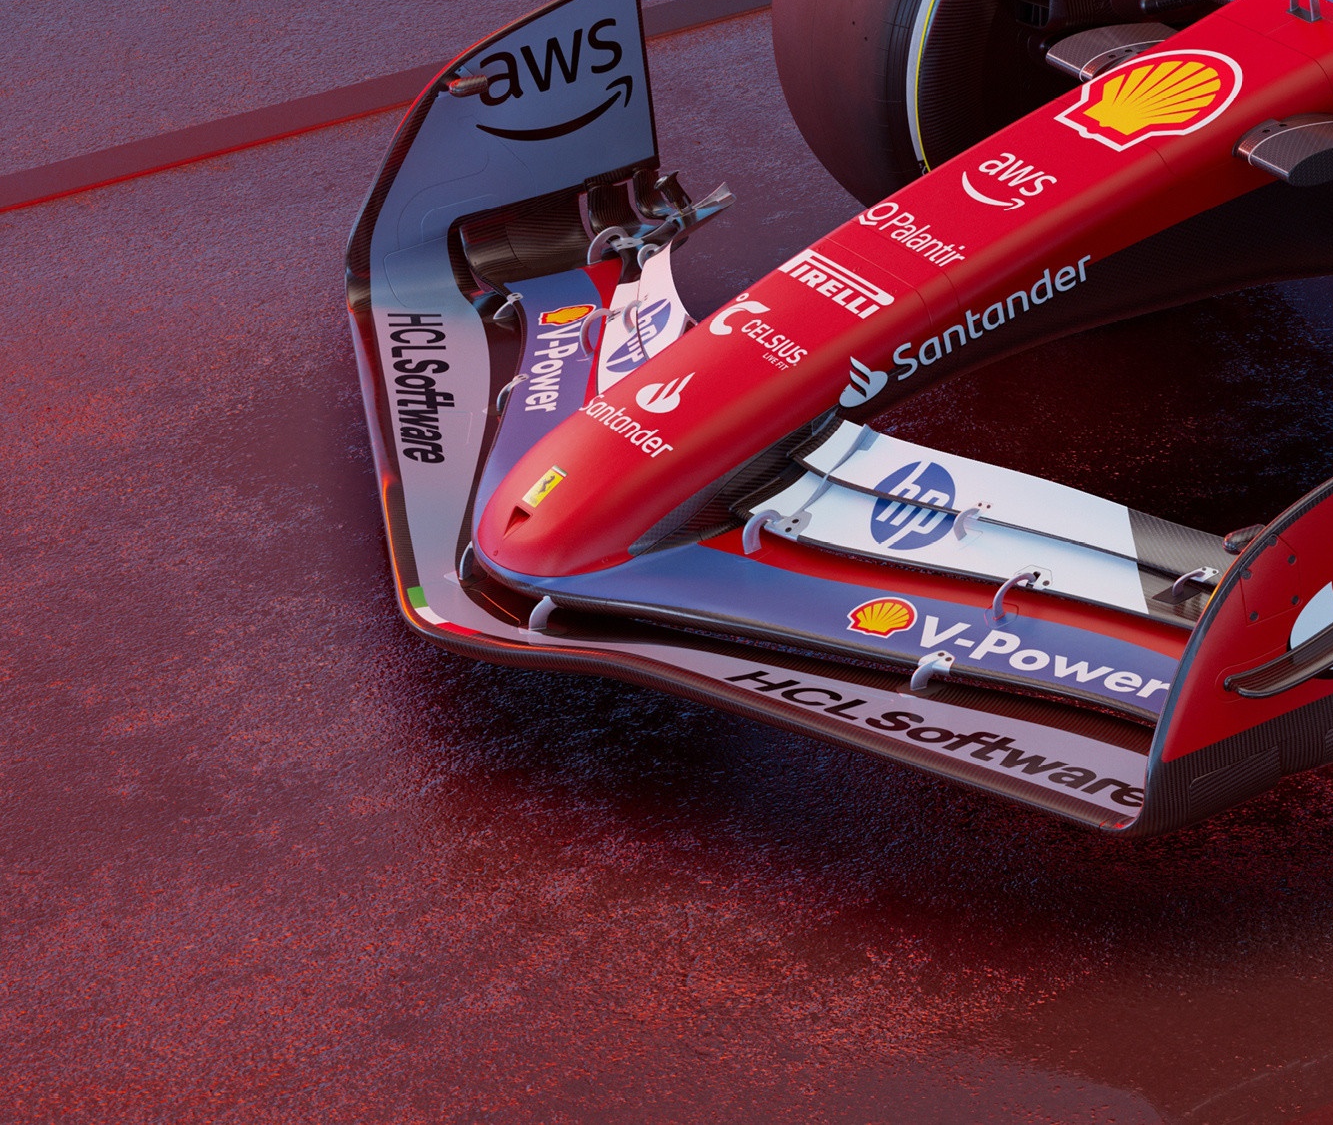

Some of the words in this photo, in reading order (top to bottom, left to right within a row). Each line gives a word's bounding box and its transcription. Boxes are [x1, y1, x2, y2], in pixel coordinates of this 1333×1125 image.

[478, 18, 623, 106] aws
[978, 153, 1057, 196] aws
[879, 212, 965, 267] Palantir
[777, 249, 895, 320] PIRELLI
[893, 255, 1091, 381] Santander
[525, 322, 582, 412] V-Power
[741, 319, 808, 364] CELSIUS
[763, 352, 779, 365] LIVE
[775, 361, 790, 371] FIT
[388, 313, 455, 464] HCLSoftware
[579, 394, 673, 458] Santander
[875, 462, 950, 551] hp
[920, 615, 1171, 701] V-Power
[724, 670, 1147, 809] HCLSoftware
